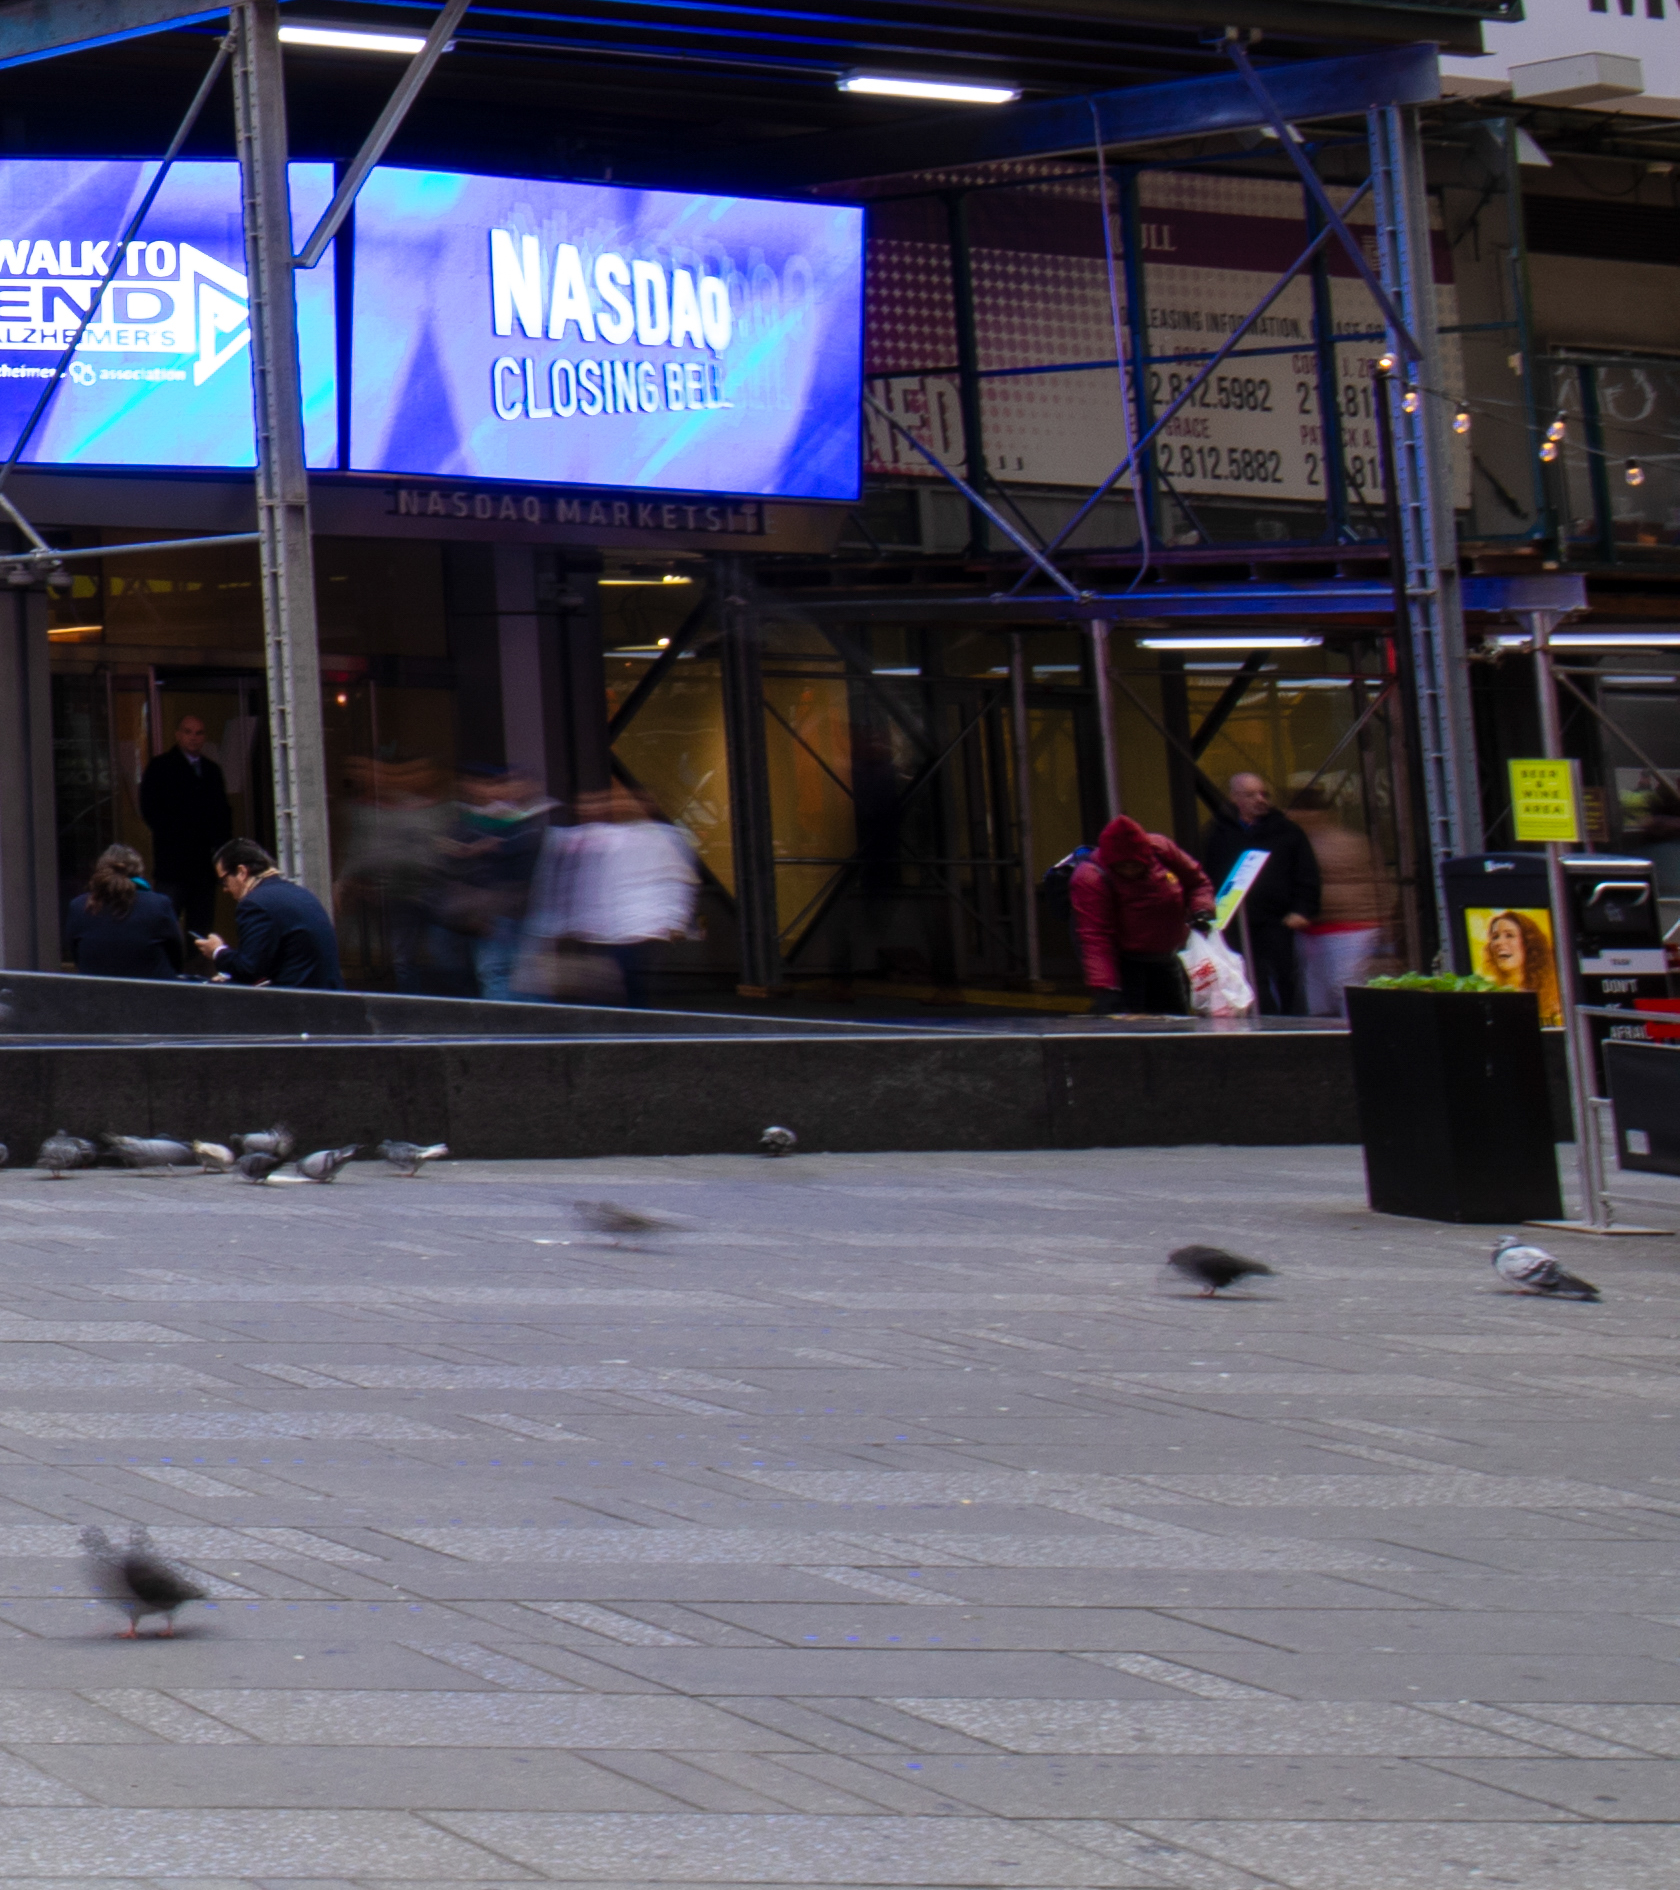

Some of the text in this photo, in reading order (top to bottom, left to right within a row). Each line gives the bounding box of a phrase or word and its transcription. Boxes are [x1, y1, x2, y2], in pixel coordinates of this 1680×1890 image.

[117, 240, 177, 278] TO
[491, 229, 732, 359] NASDAQ
[494, 356, 735, 420] CLOSING BELL
[1160, 443, 1284, 483] 2.812.5882
[396, 489, 544, 525] NASDAQ
[1521, 769, 1557, 778] BEER
[1600, 978, 1639, 994] DON'T
